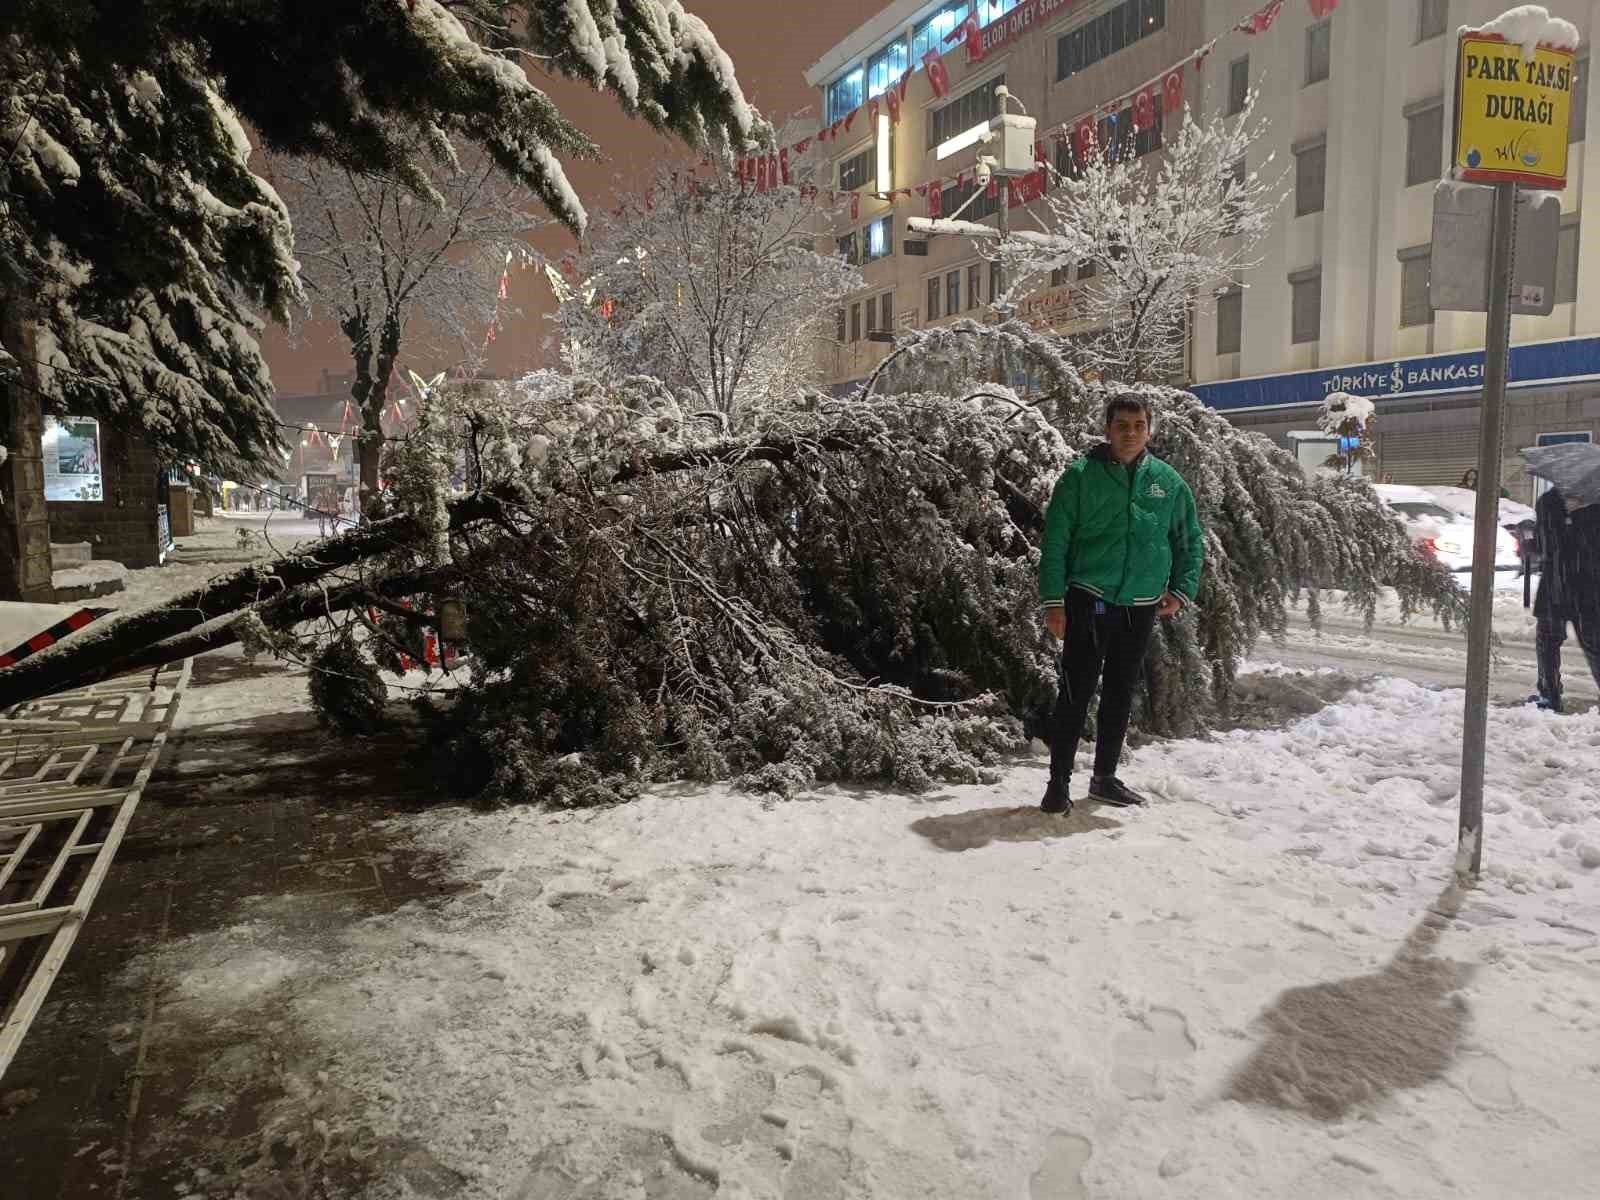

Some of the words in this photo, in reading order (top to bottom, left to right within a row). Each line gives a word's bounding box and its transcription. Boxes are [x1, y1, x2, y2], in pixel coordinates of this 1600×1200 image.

[1466, 55, 1520, 82] PARK
[1525, 62, 1570, 92] TAKSİ
[1486, 95, 1553, 125] DURAĞI
[1322, 371, 1387, 393] TÜRKİYE
[1407, 364, 1484, 385] BANKASI
